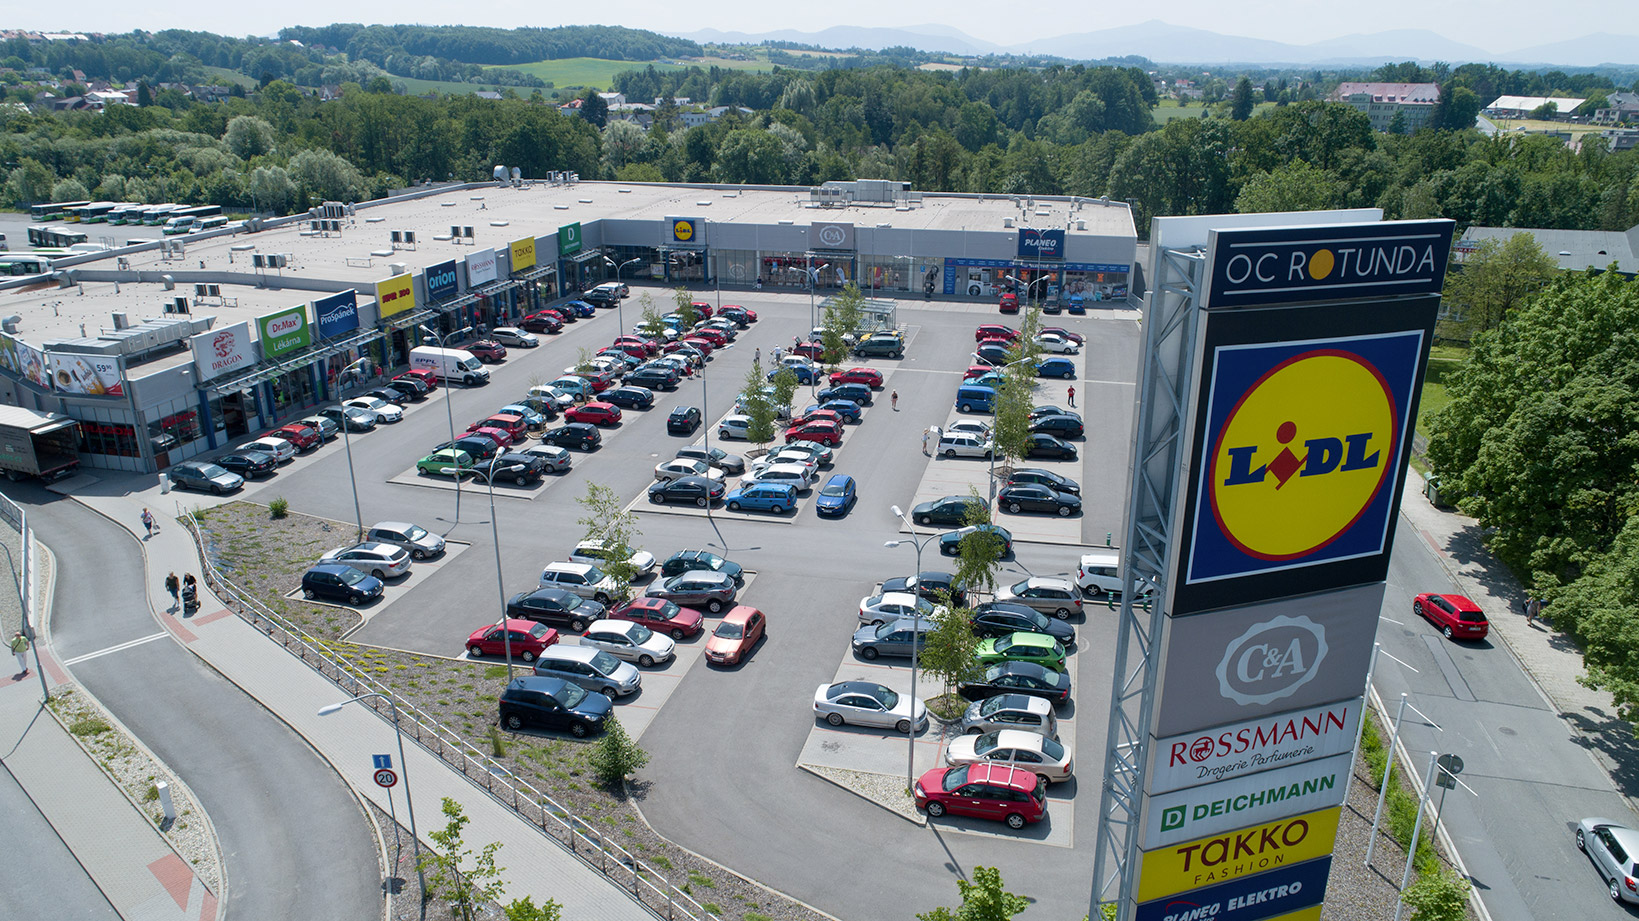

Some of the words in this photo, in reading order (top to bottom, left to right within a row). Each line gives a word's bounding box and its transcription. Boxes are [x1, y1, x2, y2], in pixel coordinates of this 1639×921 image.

[567, 227, 575, 241] D
[823, 230, 841, 241] C&A
[1024, 238, 1057, 247] PLANEO
[1226, 253, 1279, 284] OC
[1288, 244, 1436, 282] ROTUNDA
[428, 270, 456, 290] orion
[320, 305, 355, 326] ProSpánek
[271, 319, 297, 333] Dr.Max
[272, 335, 301, 351] Lékárna
[212, 353, 243, 371] DRAGON
[1236, 637, 1308, 684] C&A
[1168, 707, 1348, 768] ROSSMANN
[1196, 758, 1248, 781] Drogerie
[1250, 745, 1315, 769] Parfumerie
[378, 774, 393, 783] 20
[1163, 806, 1184, 829] D
[1192, 773, 1336, 821] DEICHMANN
[1193, 853, 1285, 885] FASHION
[1227, 881, 1303, 912] ELEKTRO
